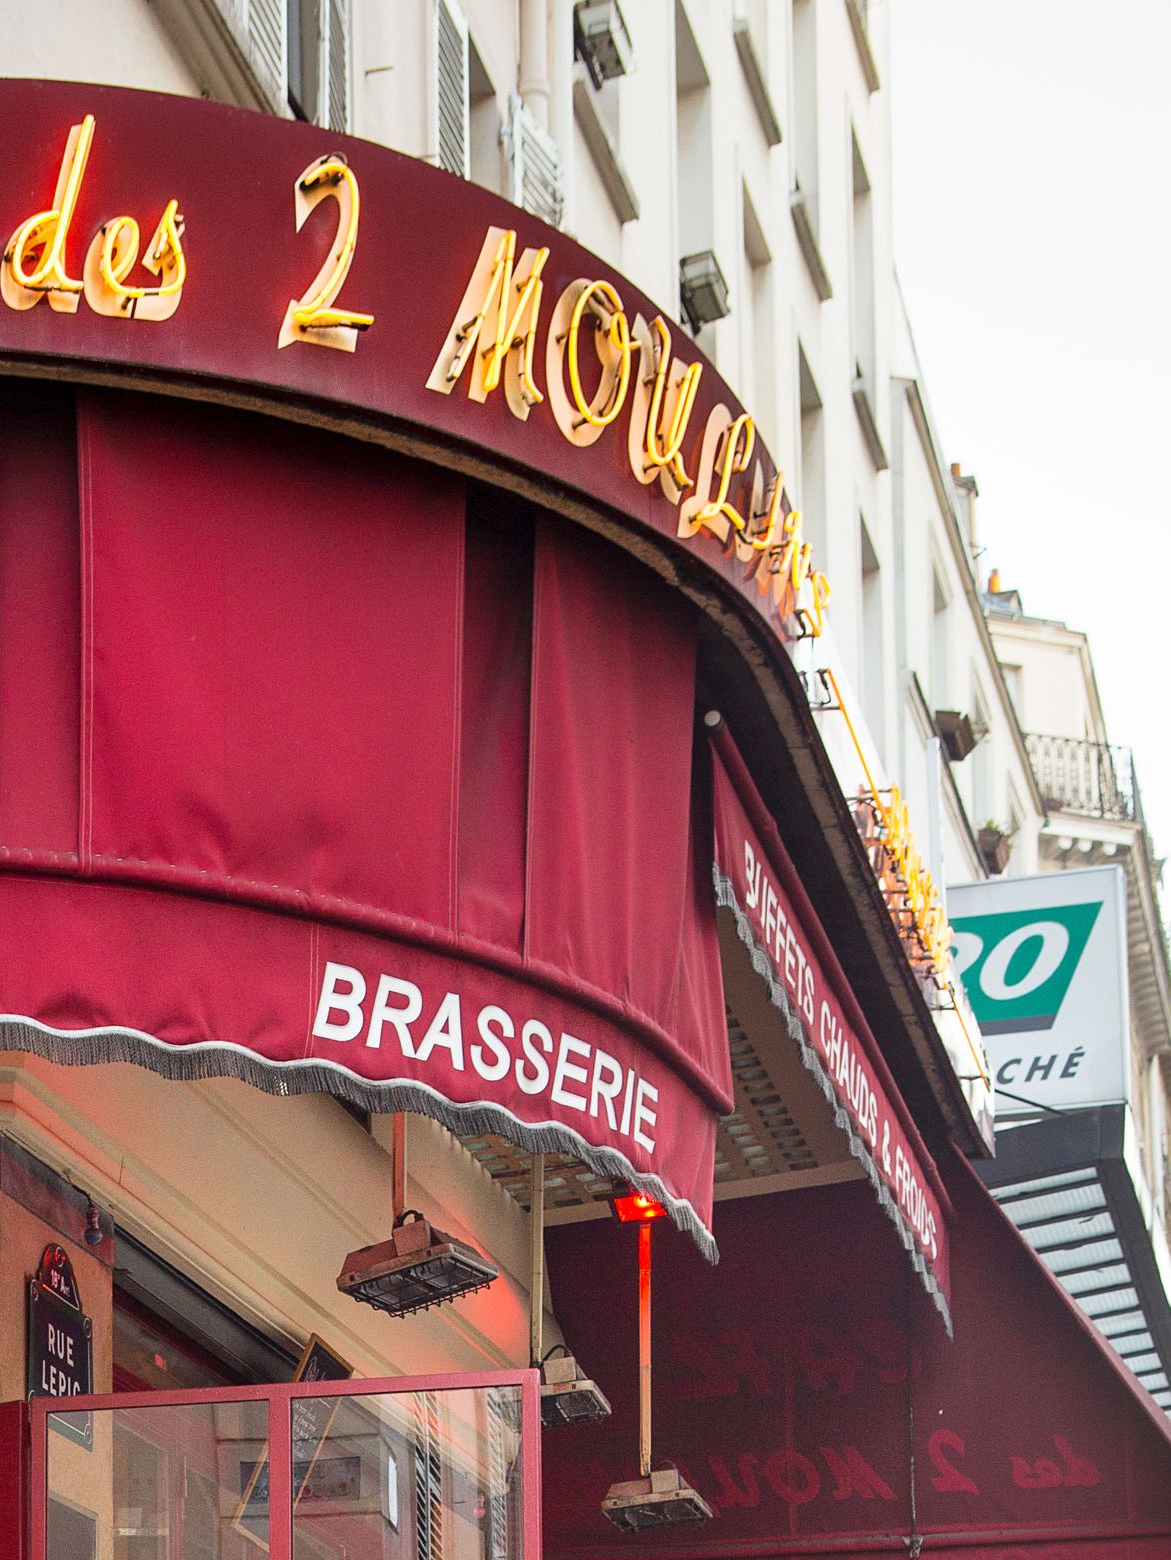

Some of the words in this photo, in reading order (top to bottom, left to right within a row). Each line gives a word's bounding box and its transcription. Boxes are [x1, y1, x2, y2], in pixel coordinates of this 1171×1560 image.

[1, 114, 187, 322] des
[278, 152, 375, 352] 2
[312, 960, 659, 1154] BRASSERIE
[820, 1000, 878, 1148] CHAUDS
[881, 1119, 892, 1176] &
[894, 1145, 937, 1260] FROIDS
[47, 1323, 75, 1368] RUE
